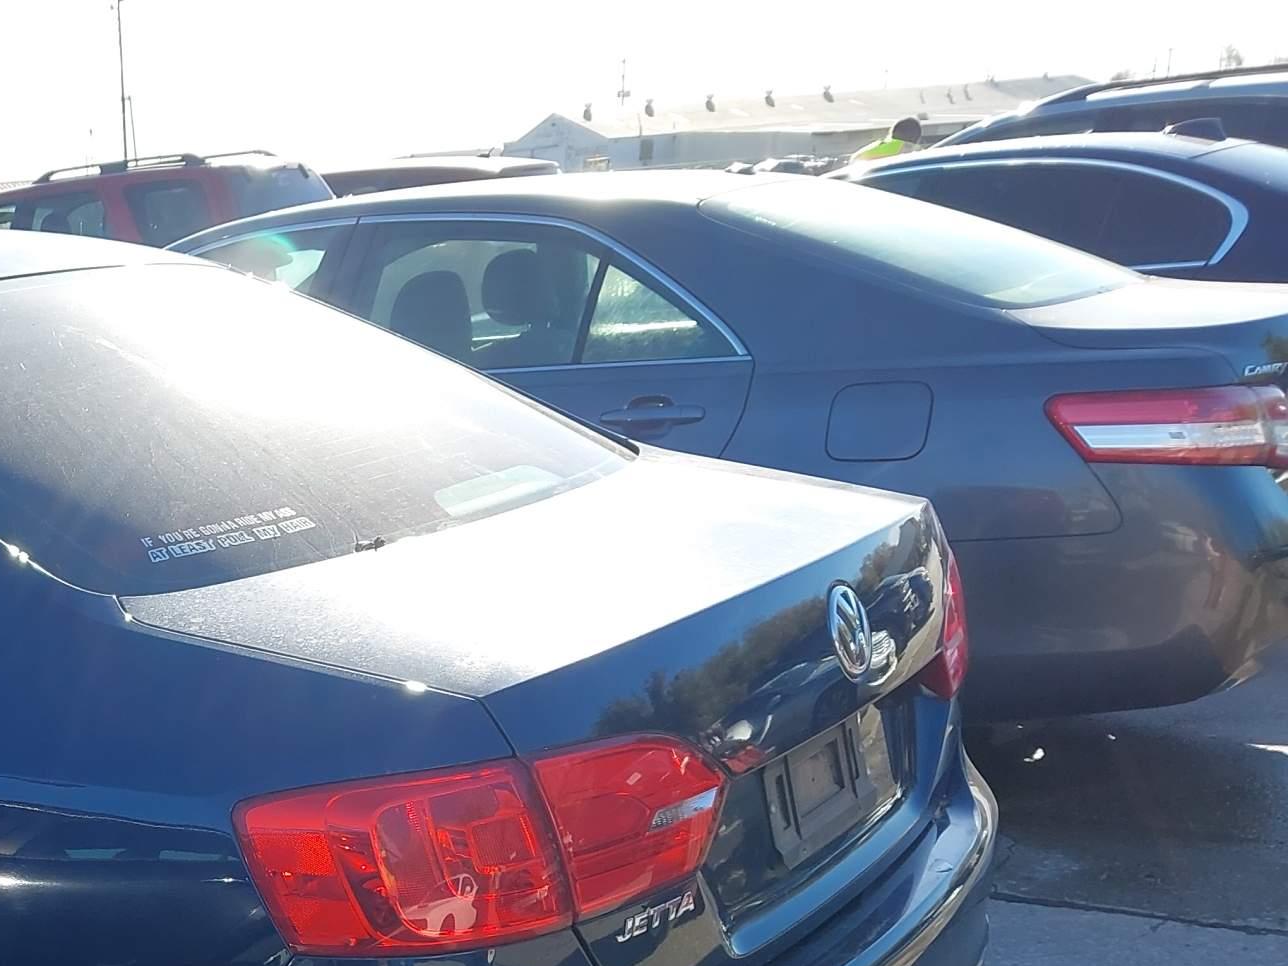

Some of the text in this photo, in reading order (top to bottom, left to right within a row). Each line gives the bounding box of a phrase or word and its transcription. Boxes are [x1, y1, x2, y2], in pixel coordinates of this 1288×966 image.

[140, 536, 154, 548] IF
[158, 528, 201, 544] YOU'RE
[198, 520, 240, 537] GONNA
[234, 514, 263, 527] RIDE
[256, 510, 277, 522] MY
[148, 547, 170, 563] AT
[168, 538, 217, 558] LEAST
[252, 524, 281, 540] MY
[277, 516, 316, 534] HAIR
[615, 890, 695, 943] JETTA
